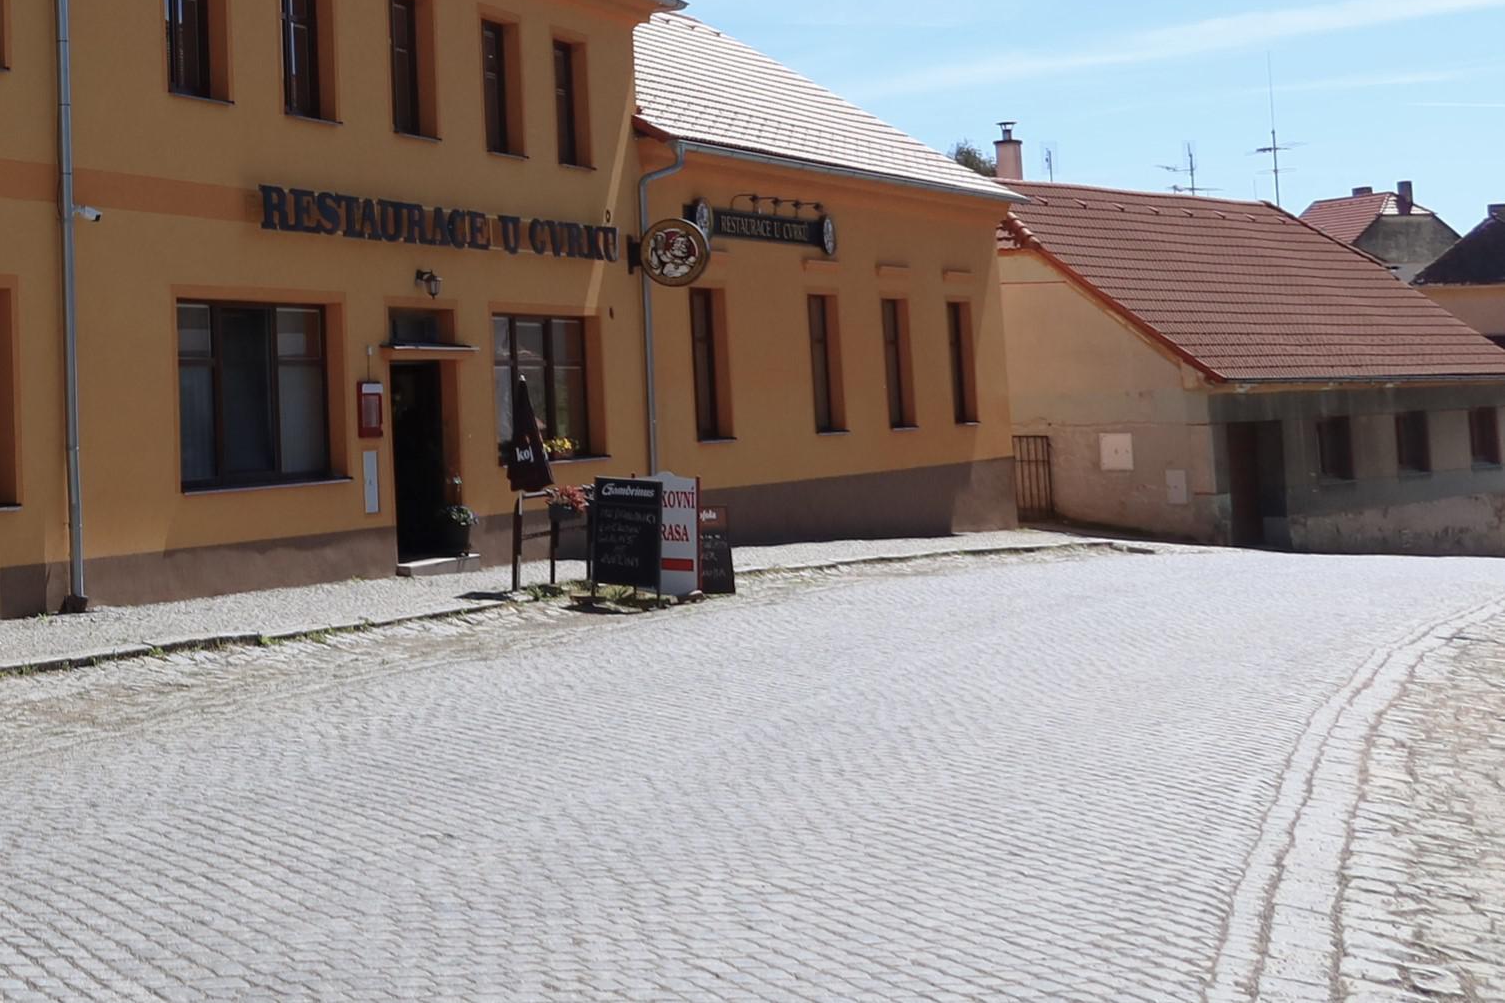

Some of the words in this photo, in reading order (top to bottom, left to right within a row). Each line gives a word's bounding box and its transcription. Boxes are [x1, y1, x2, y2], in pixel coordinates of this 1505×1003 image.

[258, 184, 491, 251] RESTAURACE
[497, 213, 521, 256] U
[720, 214, 772, 237] RESTAURACE
[774, 220, 781, 239] U
[601, 483, 656, 498] Gambrinus
